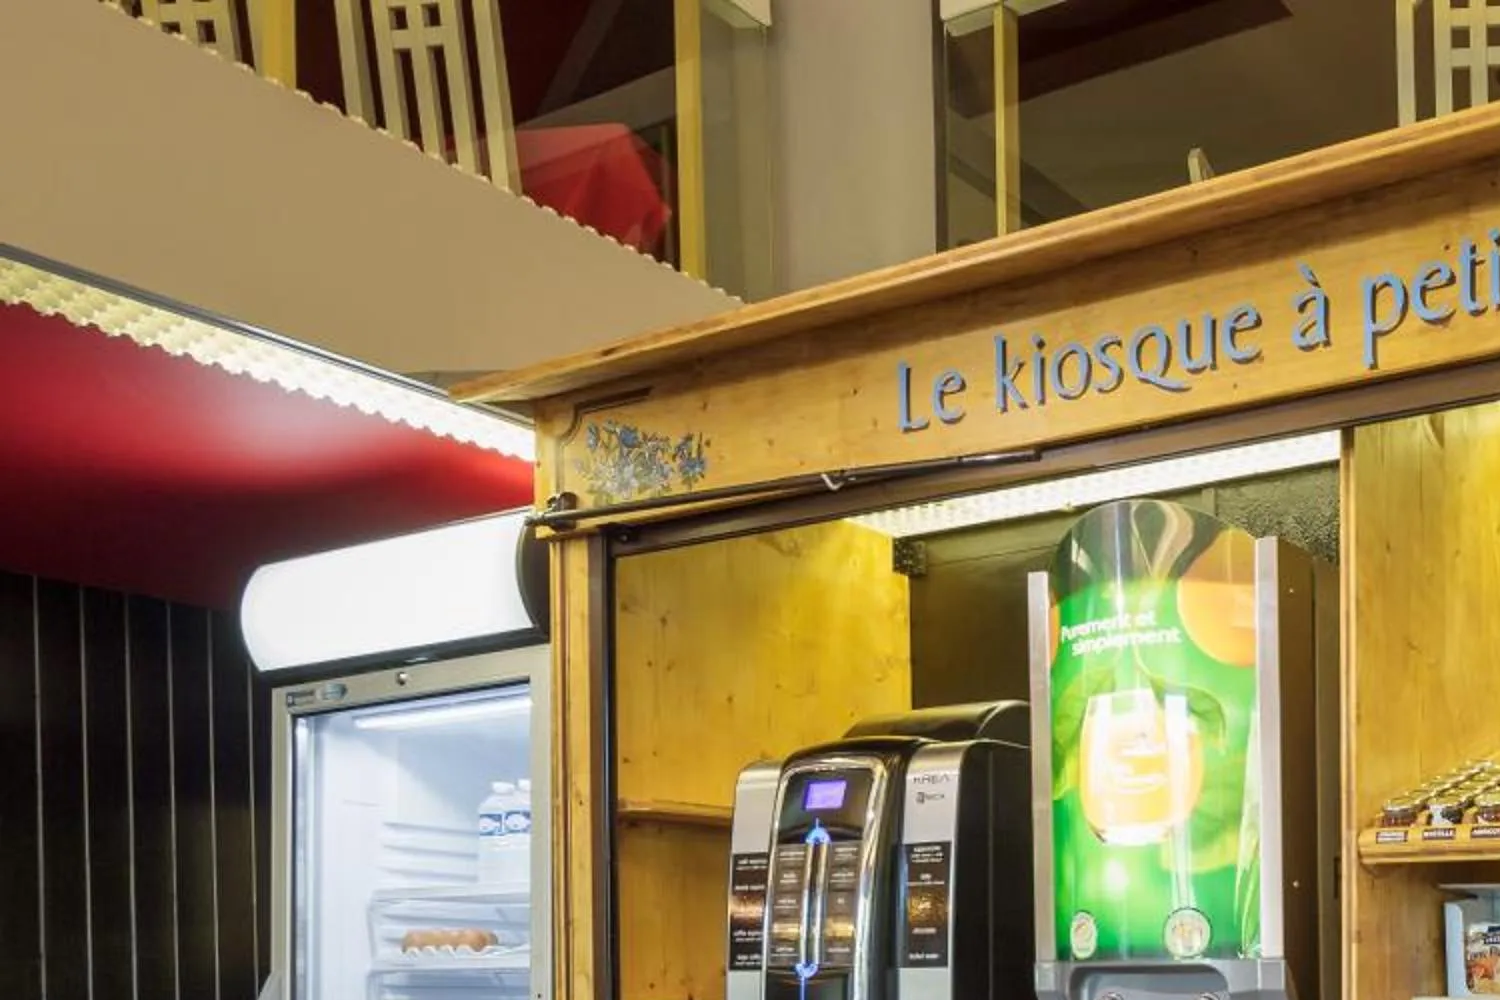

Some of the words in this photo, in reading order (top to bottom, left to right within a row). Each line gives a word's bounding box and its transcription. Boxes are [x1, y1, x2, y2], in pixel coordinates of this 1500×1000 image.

[897, 360, 967, 432] Le
[994, 304, 1263, 415] kiosque
[1291, 268, 1332, 350] à
